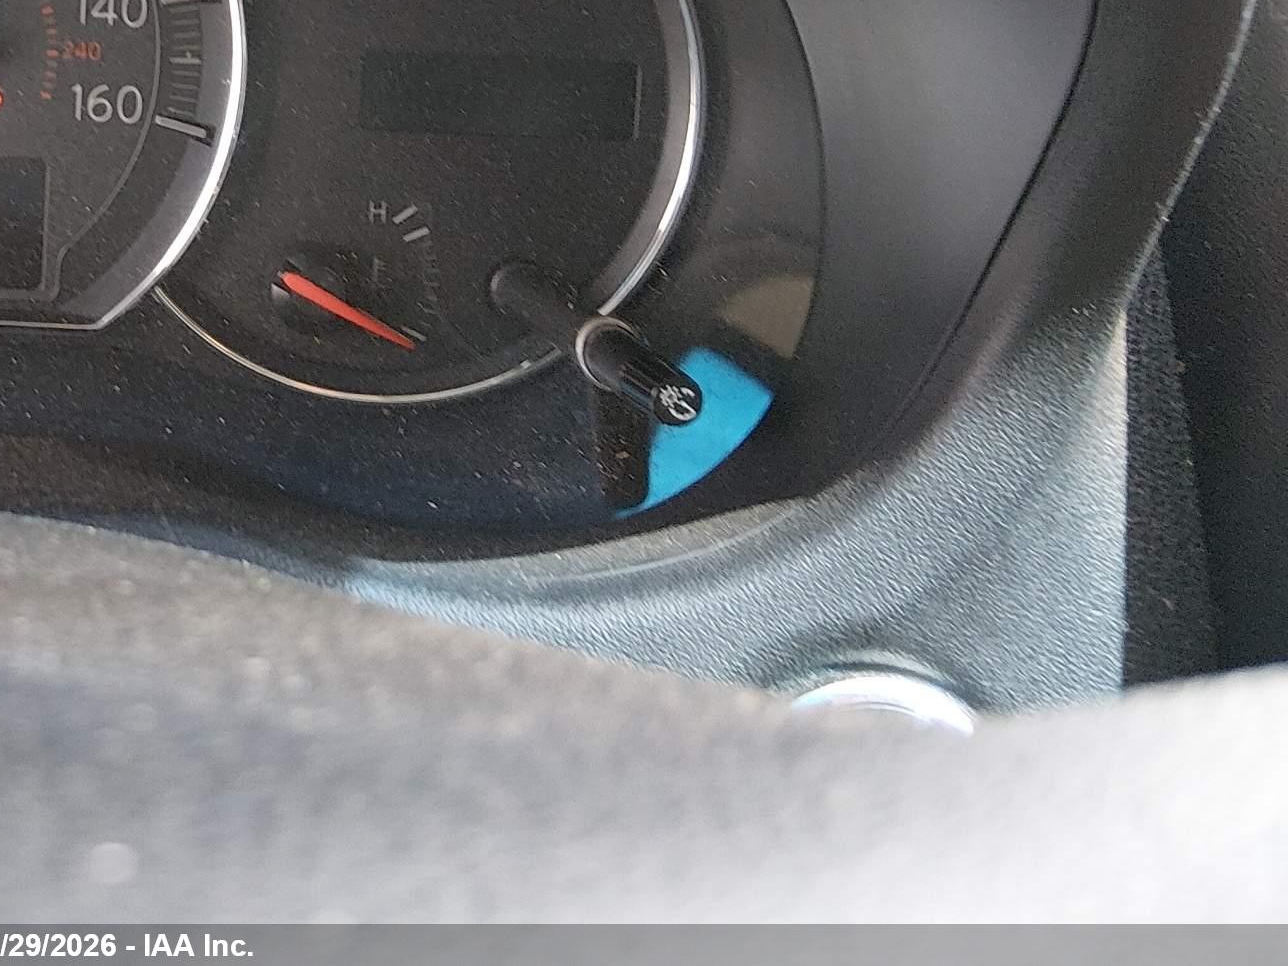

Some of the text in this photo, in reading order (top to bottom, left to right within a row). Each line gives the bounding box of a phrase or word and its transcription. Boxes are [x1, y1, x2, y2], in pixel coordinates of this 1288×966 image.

[62, 42, 102, 62] 240
[70, 84, 143, 123] 160
[369, 202, 386, 223] H
